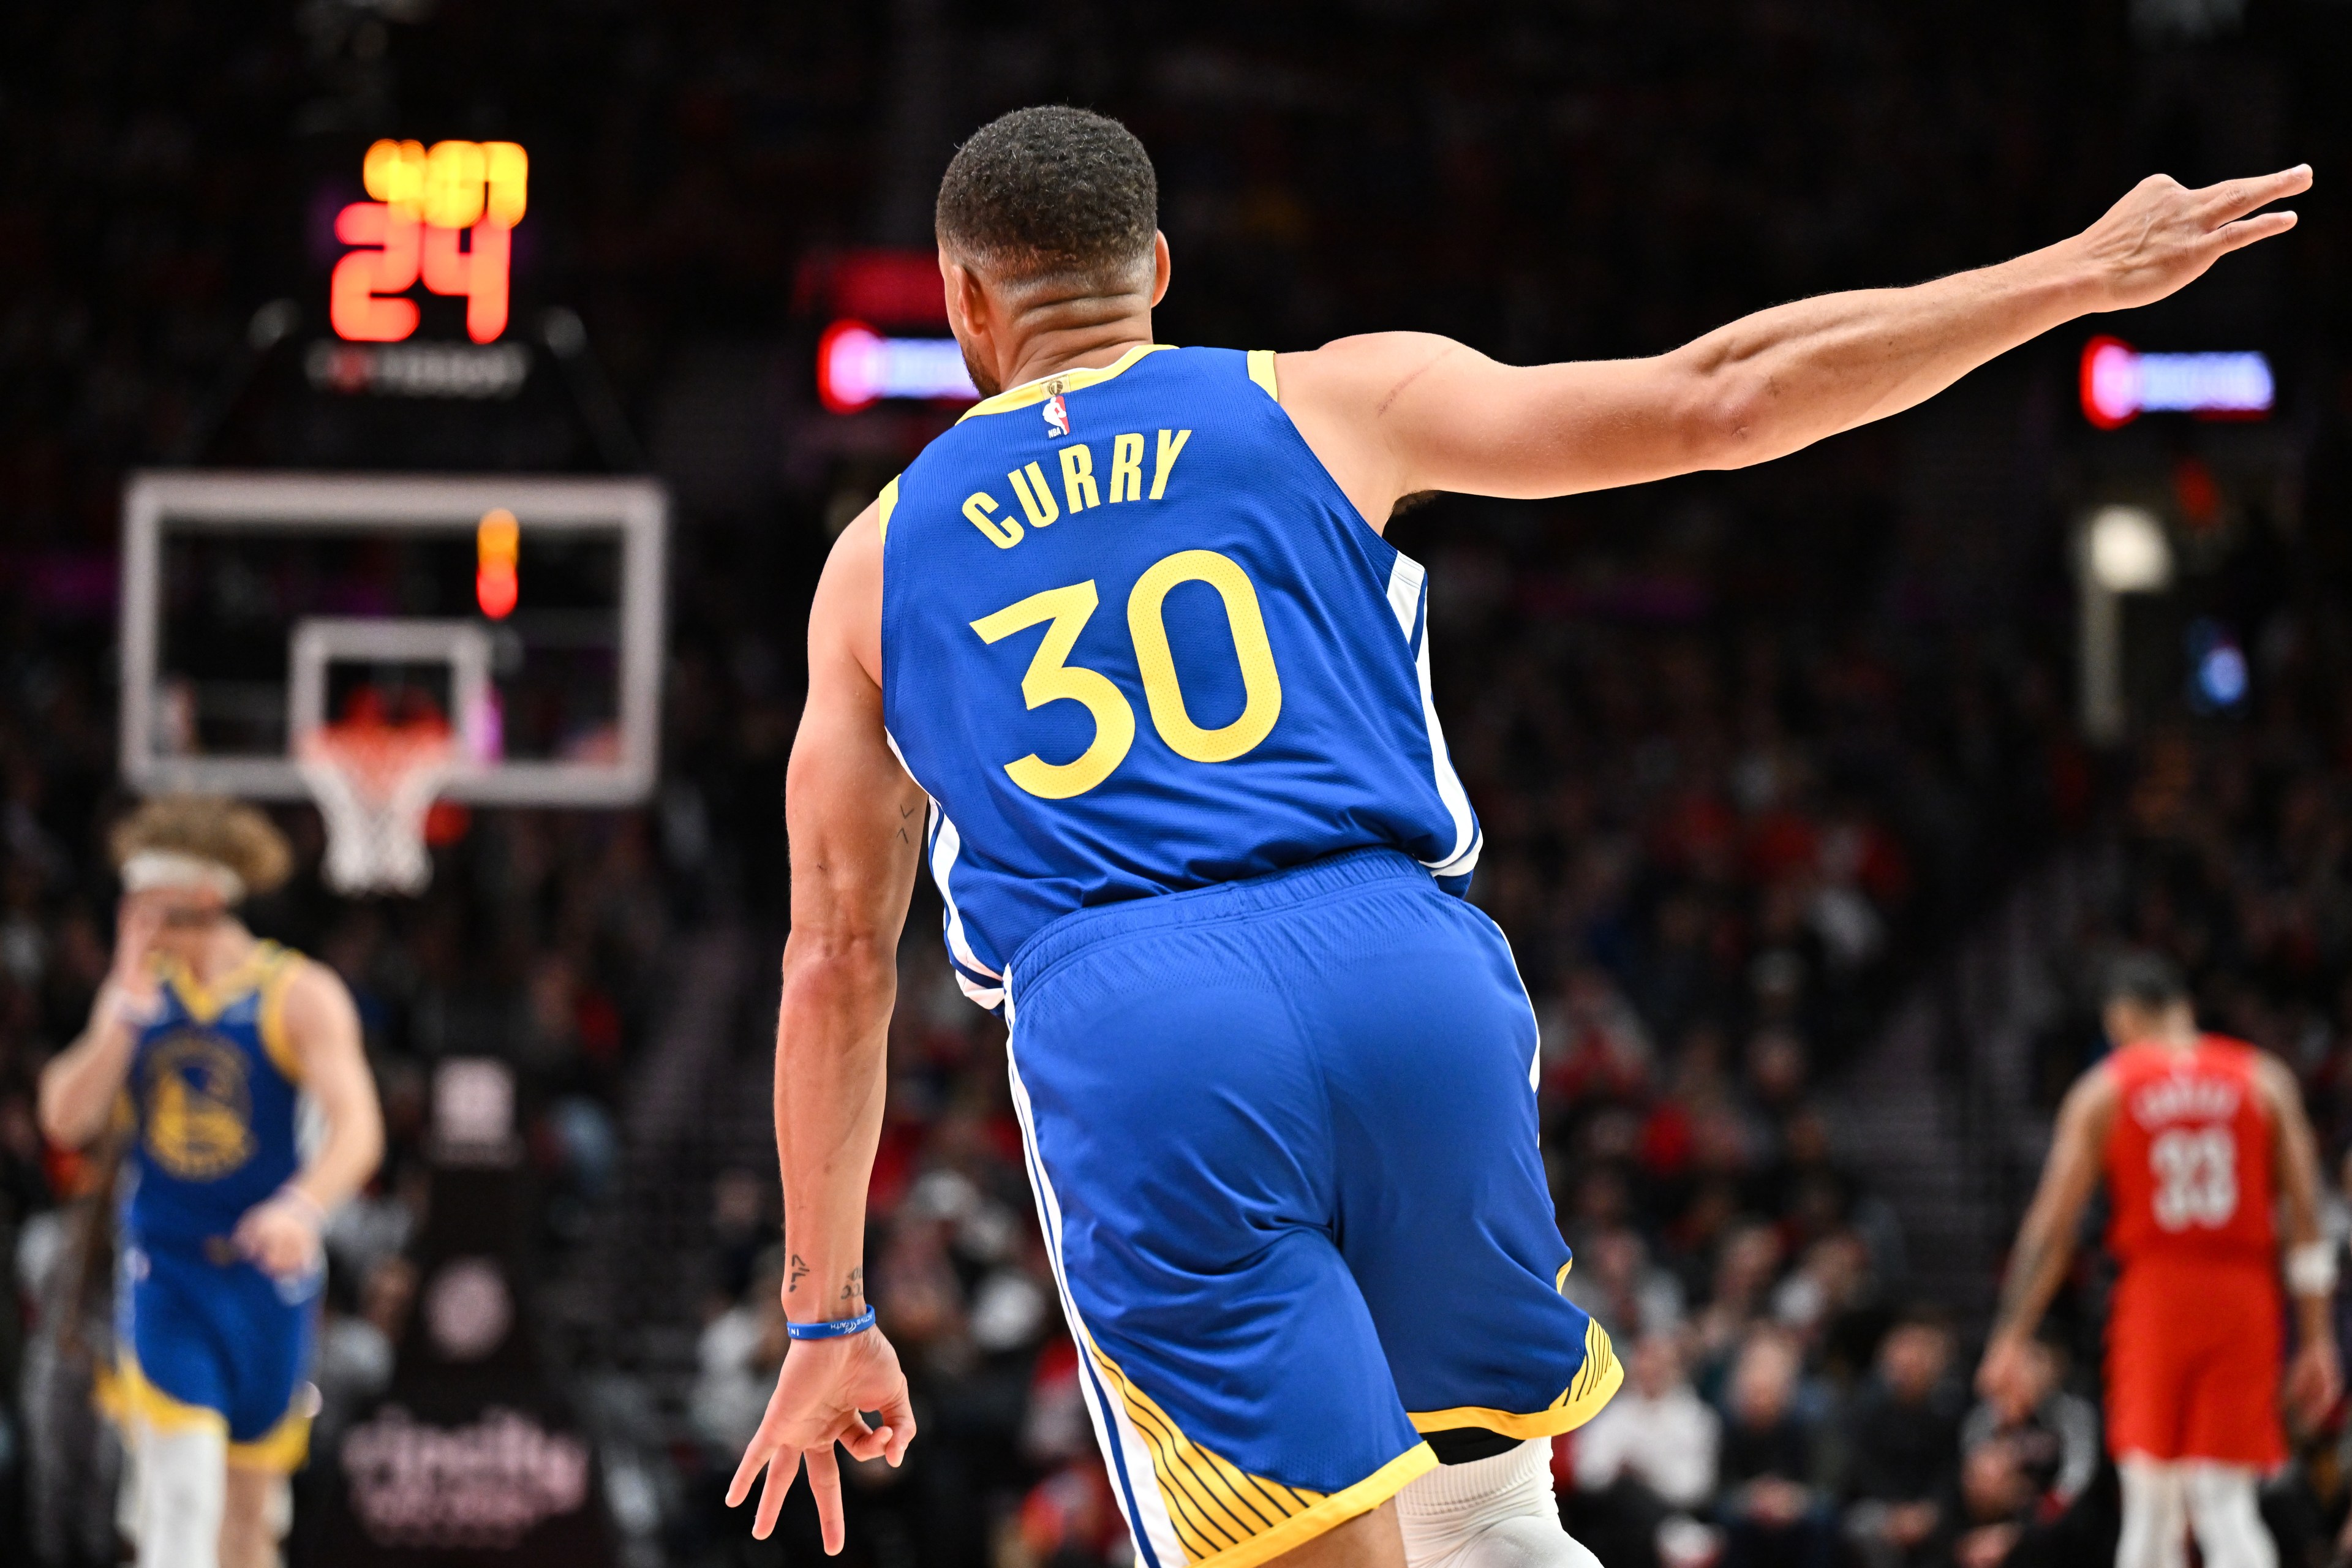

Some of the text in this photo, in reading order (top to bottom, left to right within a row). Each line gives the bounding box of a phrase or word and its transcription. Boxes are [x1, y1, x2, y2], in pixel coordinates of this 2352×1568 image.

[331, 201, 512, 345] 24
[962, 429, 1192, 549] CURRY
[1048, 427, 1061, 439] NBA
[969, 549, 1282, 799] 30
